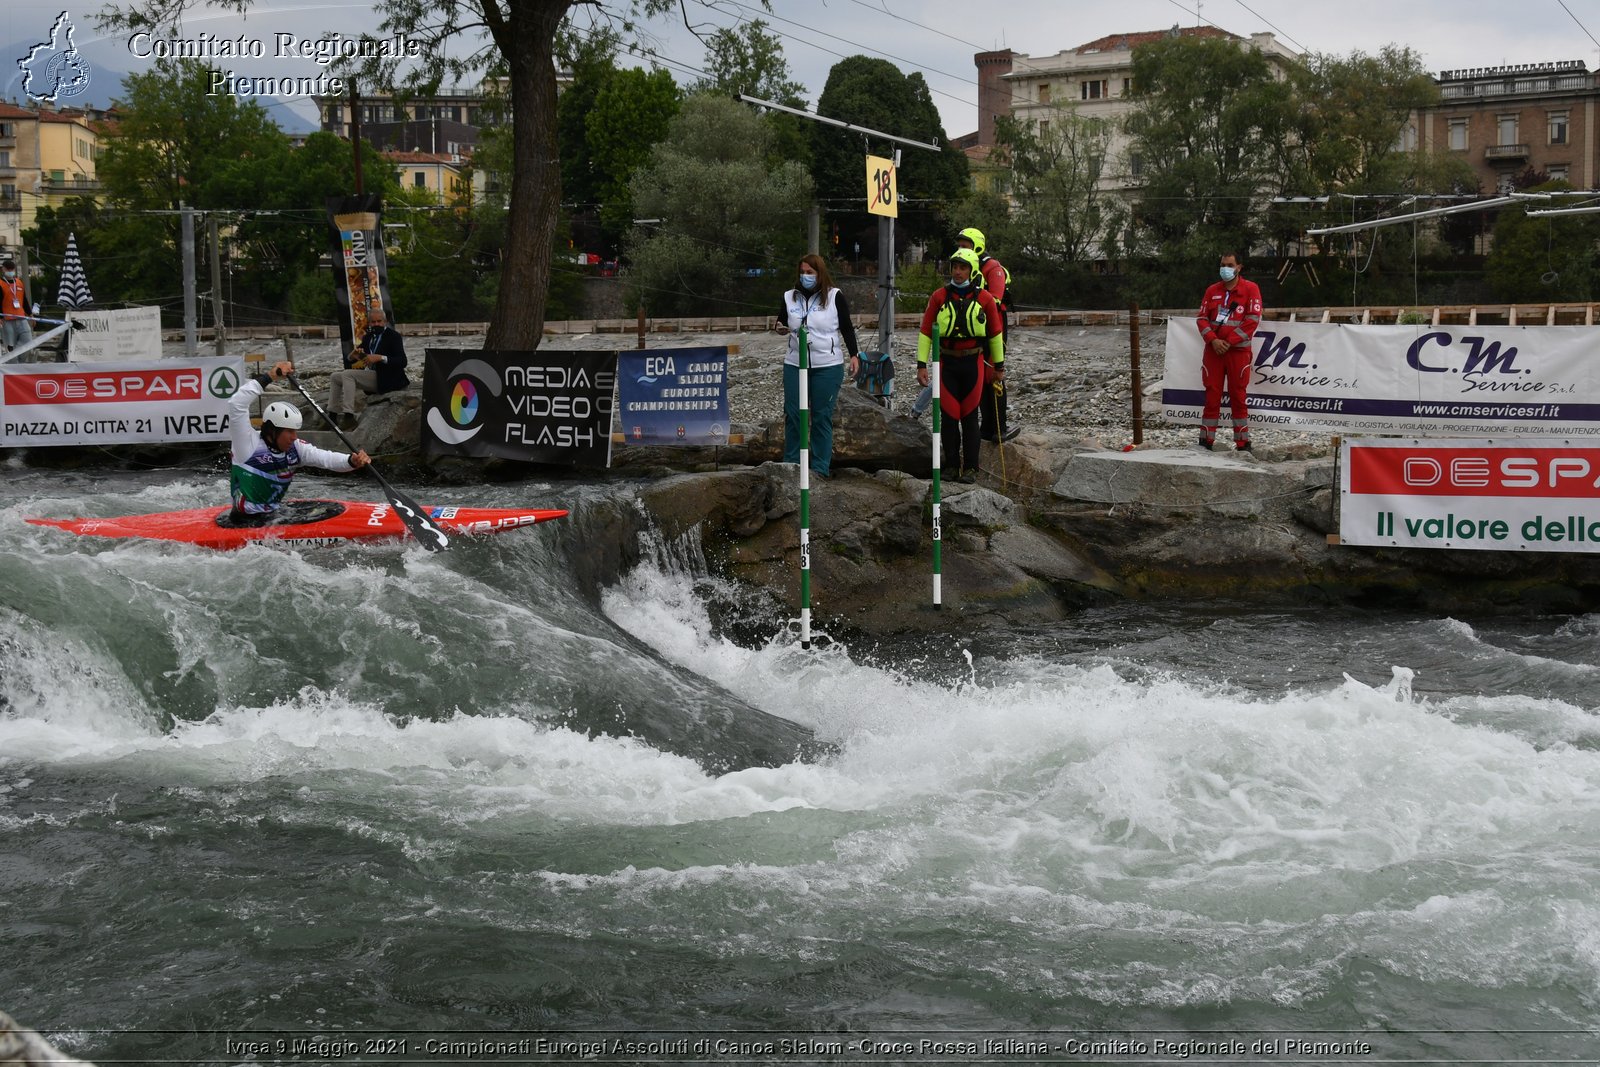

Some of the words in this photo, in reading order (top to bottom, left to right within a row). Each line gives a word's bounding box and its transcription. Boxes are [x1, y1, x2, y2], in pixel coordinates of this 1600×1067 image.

[874, 168, 891, 205] 18
[352, 230, 366, 267] KIND
[645, 356, 676, 376] ECA
[688, 362, 724, 373] CANOE
[1254, 364, 1331, 385] Service
[35, 374, 199, 398] DESPAR
[505, 366, 591, 389] MEDIA
[680, 374, 722, 384] SLALOM
[1461, 371, 1545, 393] Service
[662, 387, 720, 397] EUROPEAN
[506, 395, 591, 419] VIDEO
[628, 400, 718, 411] CHAMPIONSHIPS
[1412, 404, 1560, 418] www.cmservicesrl.it
[5, 422, 59, 436] PIAZZA
[63, 421, 79, 434] DI
[135, 419, 152, 433] 21
[505, 423, 593, 448] FLASH
[1295, 418, 1350, 427] SANIFICAZIONE
[1354, 420, 1394, 429] LOGISTICA
[1399, 422, 1438, 431] VIGILANZA
[1442, 424, 1508, 433] PROGETTAZIONE
[1513, 426, 1545, 434] EDILIZIA
[1403, 457, 1600, 488] DESP
[1405, 513, 1509, 540] valore
